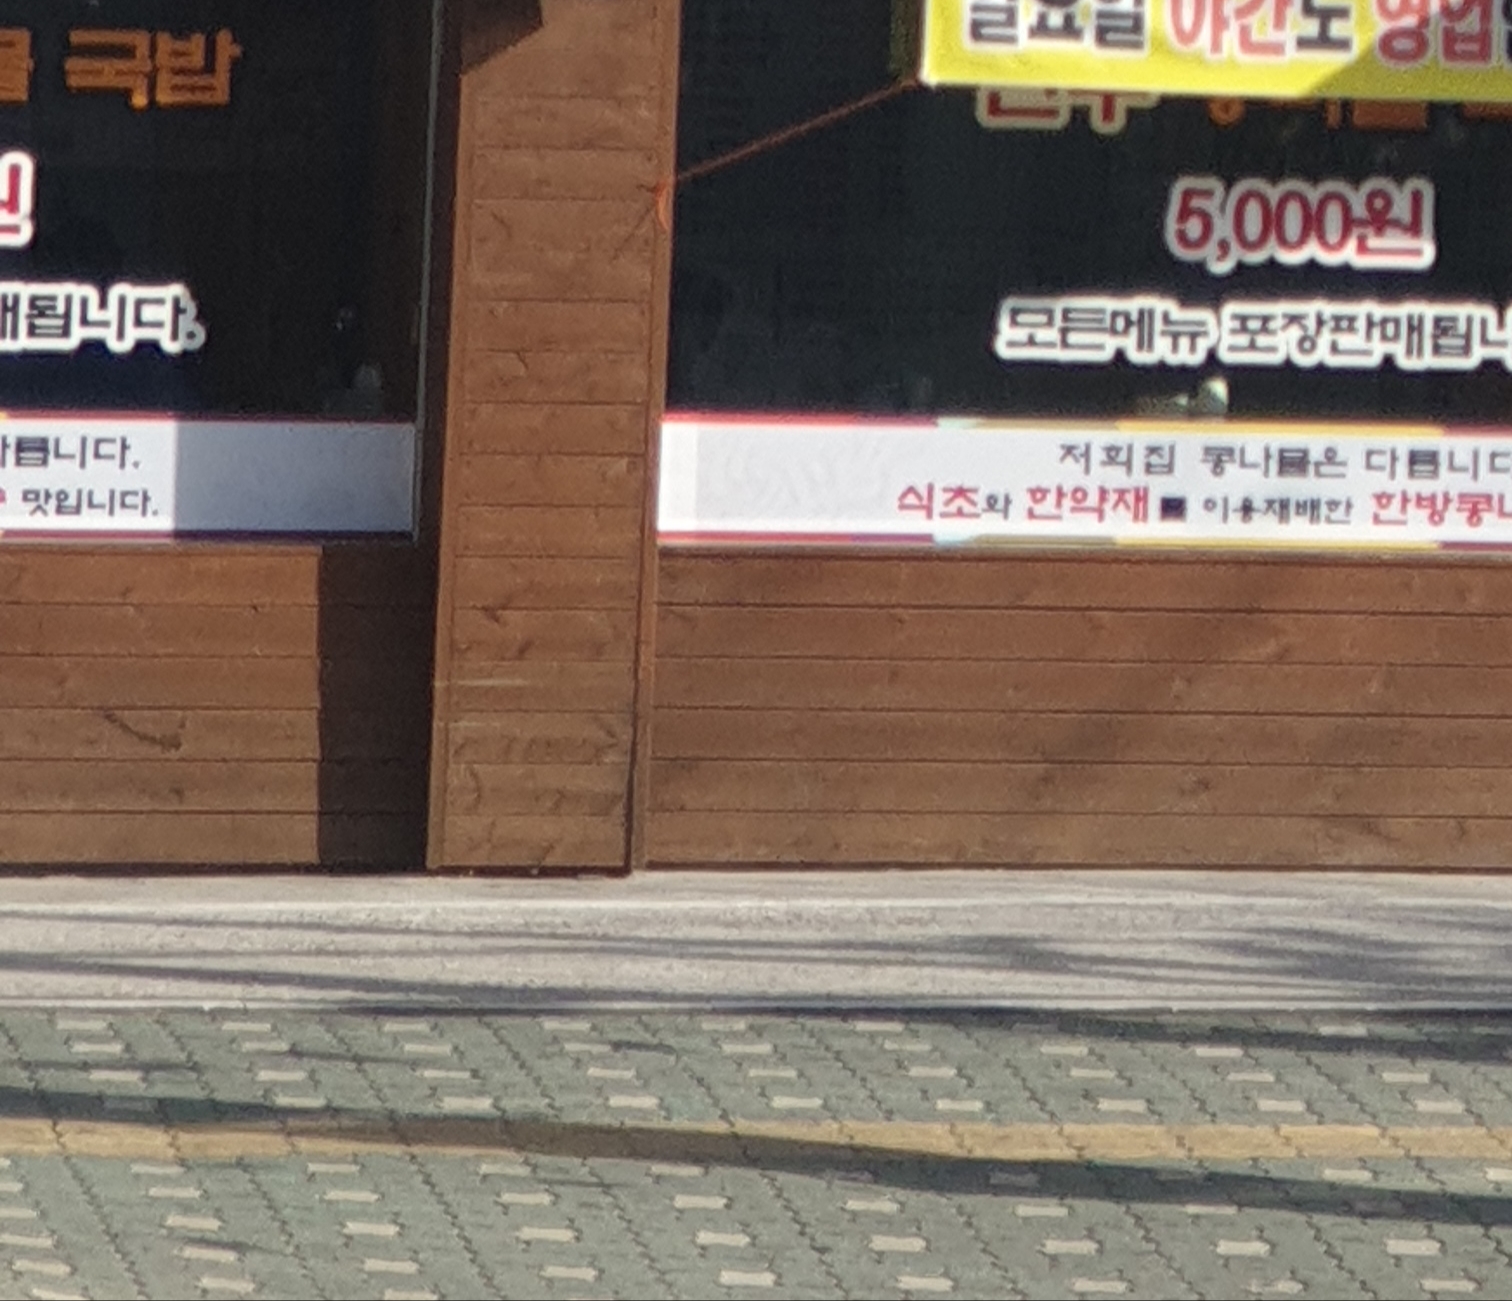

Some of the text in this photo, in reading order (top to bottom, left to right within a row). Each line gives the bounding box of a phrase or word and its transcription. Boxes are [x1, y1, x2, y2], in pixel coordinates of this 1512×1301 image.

[64, 27, 243, 109] 국밥
[1170, 181, 1430, 266] 5,000원
[1059, 441, 1178, 477] 저희집
[896, 481, 1014, 521] 식초와
